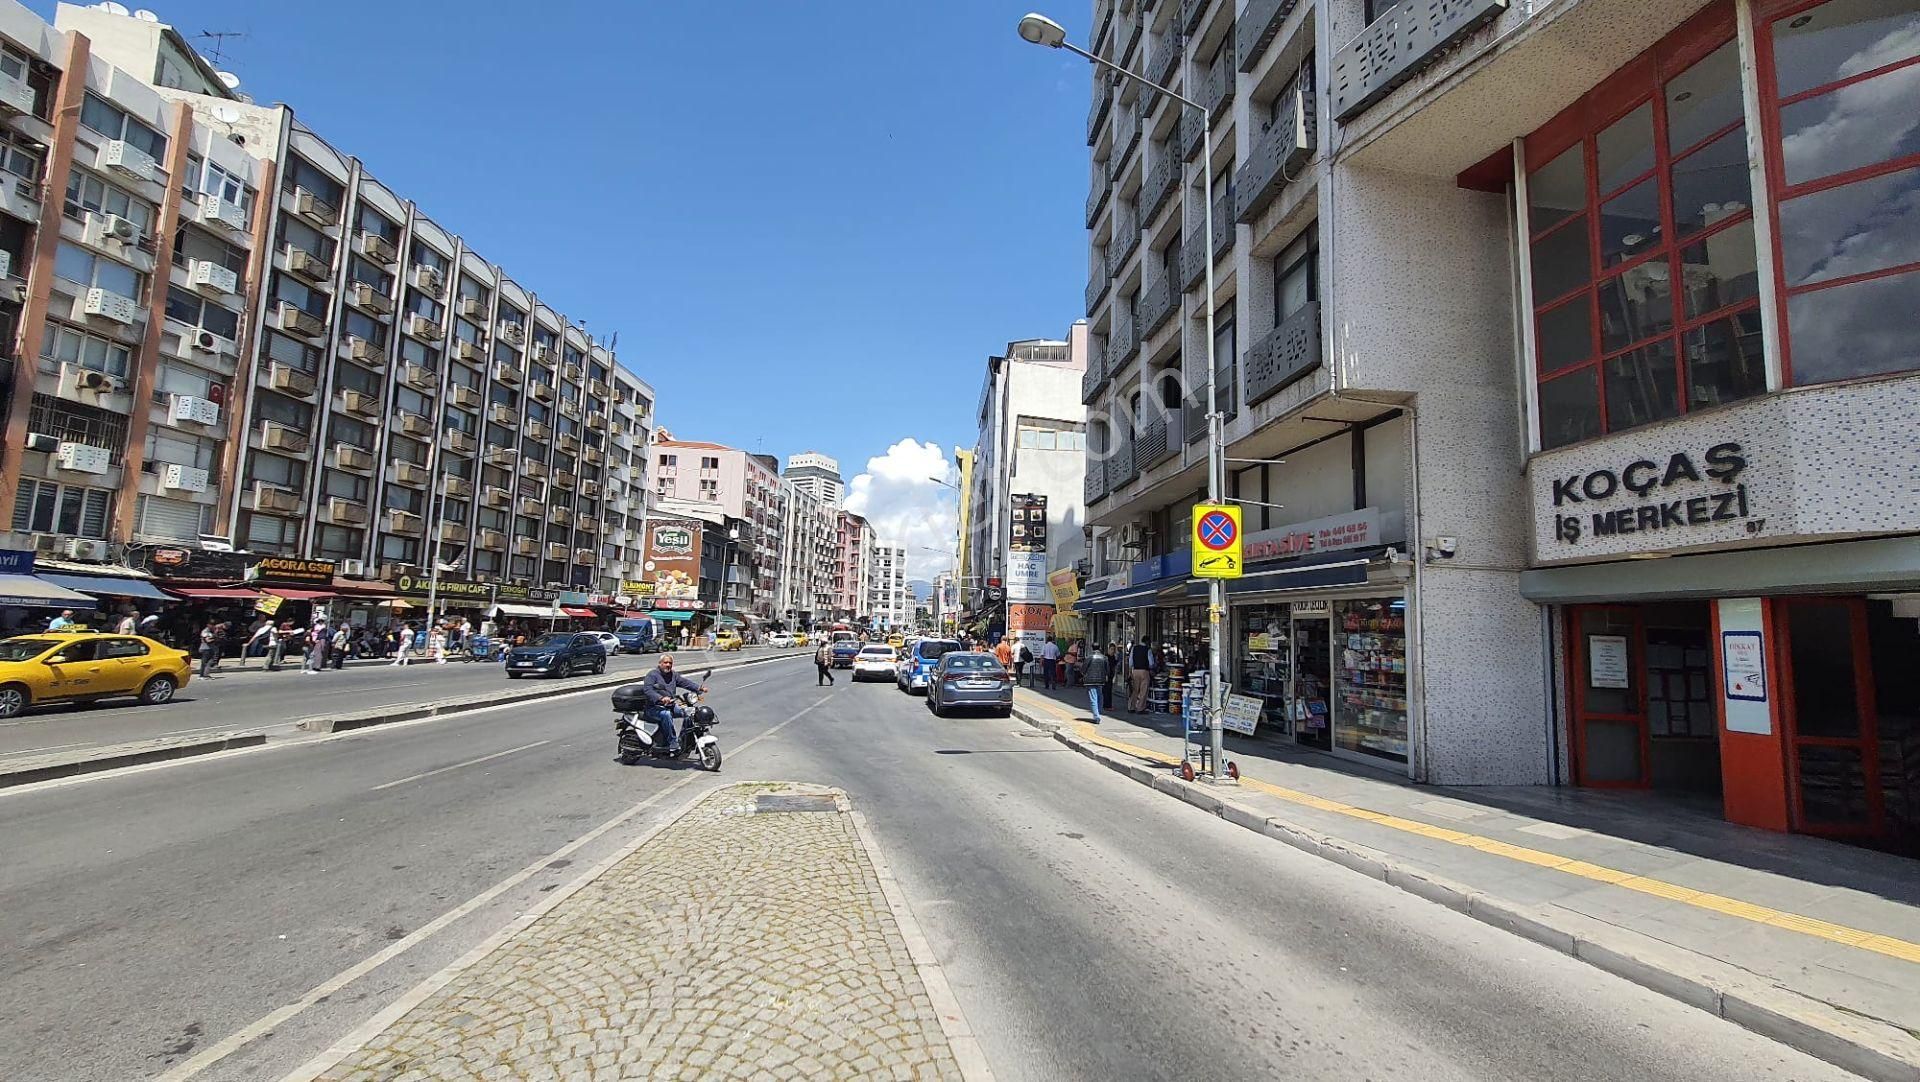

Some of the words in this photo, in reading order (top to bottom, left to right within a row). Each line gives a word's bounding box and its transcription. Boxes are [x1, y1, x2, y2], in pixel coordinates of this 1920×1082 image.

[1552, 442, 1748, 506] KOÇAŞ
[1555, 513, 1580, 545] İŞ
[1592, 482, 1749, 537] MERKEZİ
[657, 532, 688, 546] Yeşil
[260, 557, 307, 571] AGORA
[308, 562, 334, 574] GSM
[1017, 562, 1037, 570] HAC
[1015, 570, 1039, 578] UMRE
[468, 584, 487, 594] CAFE
